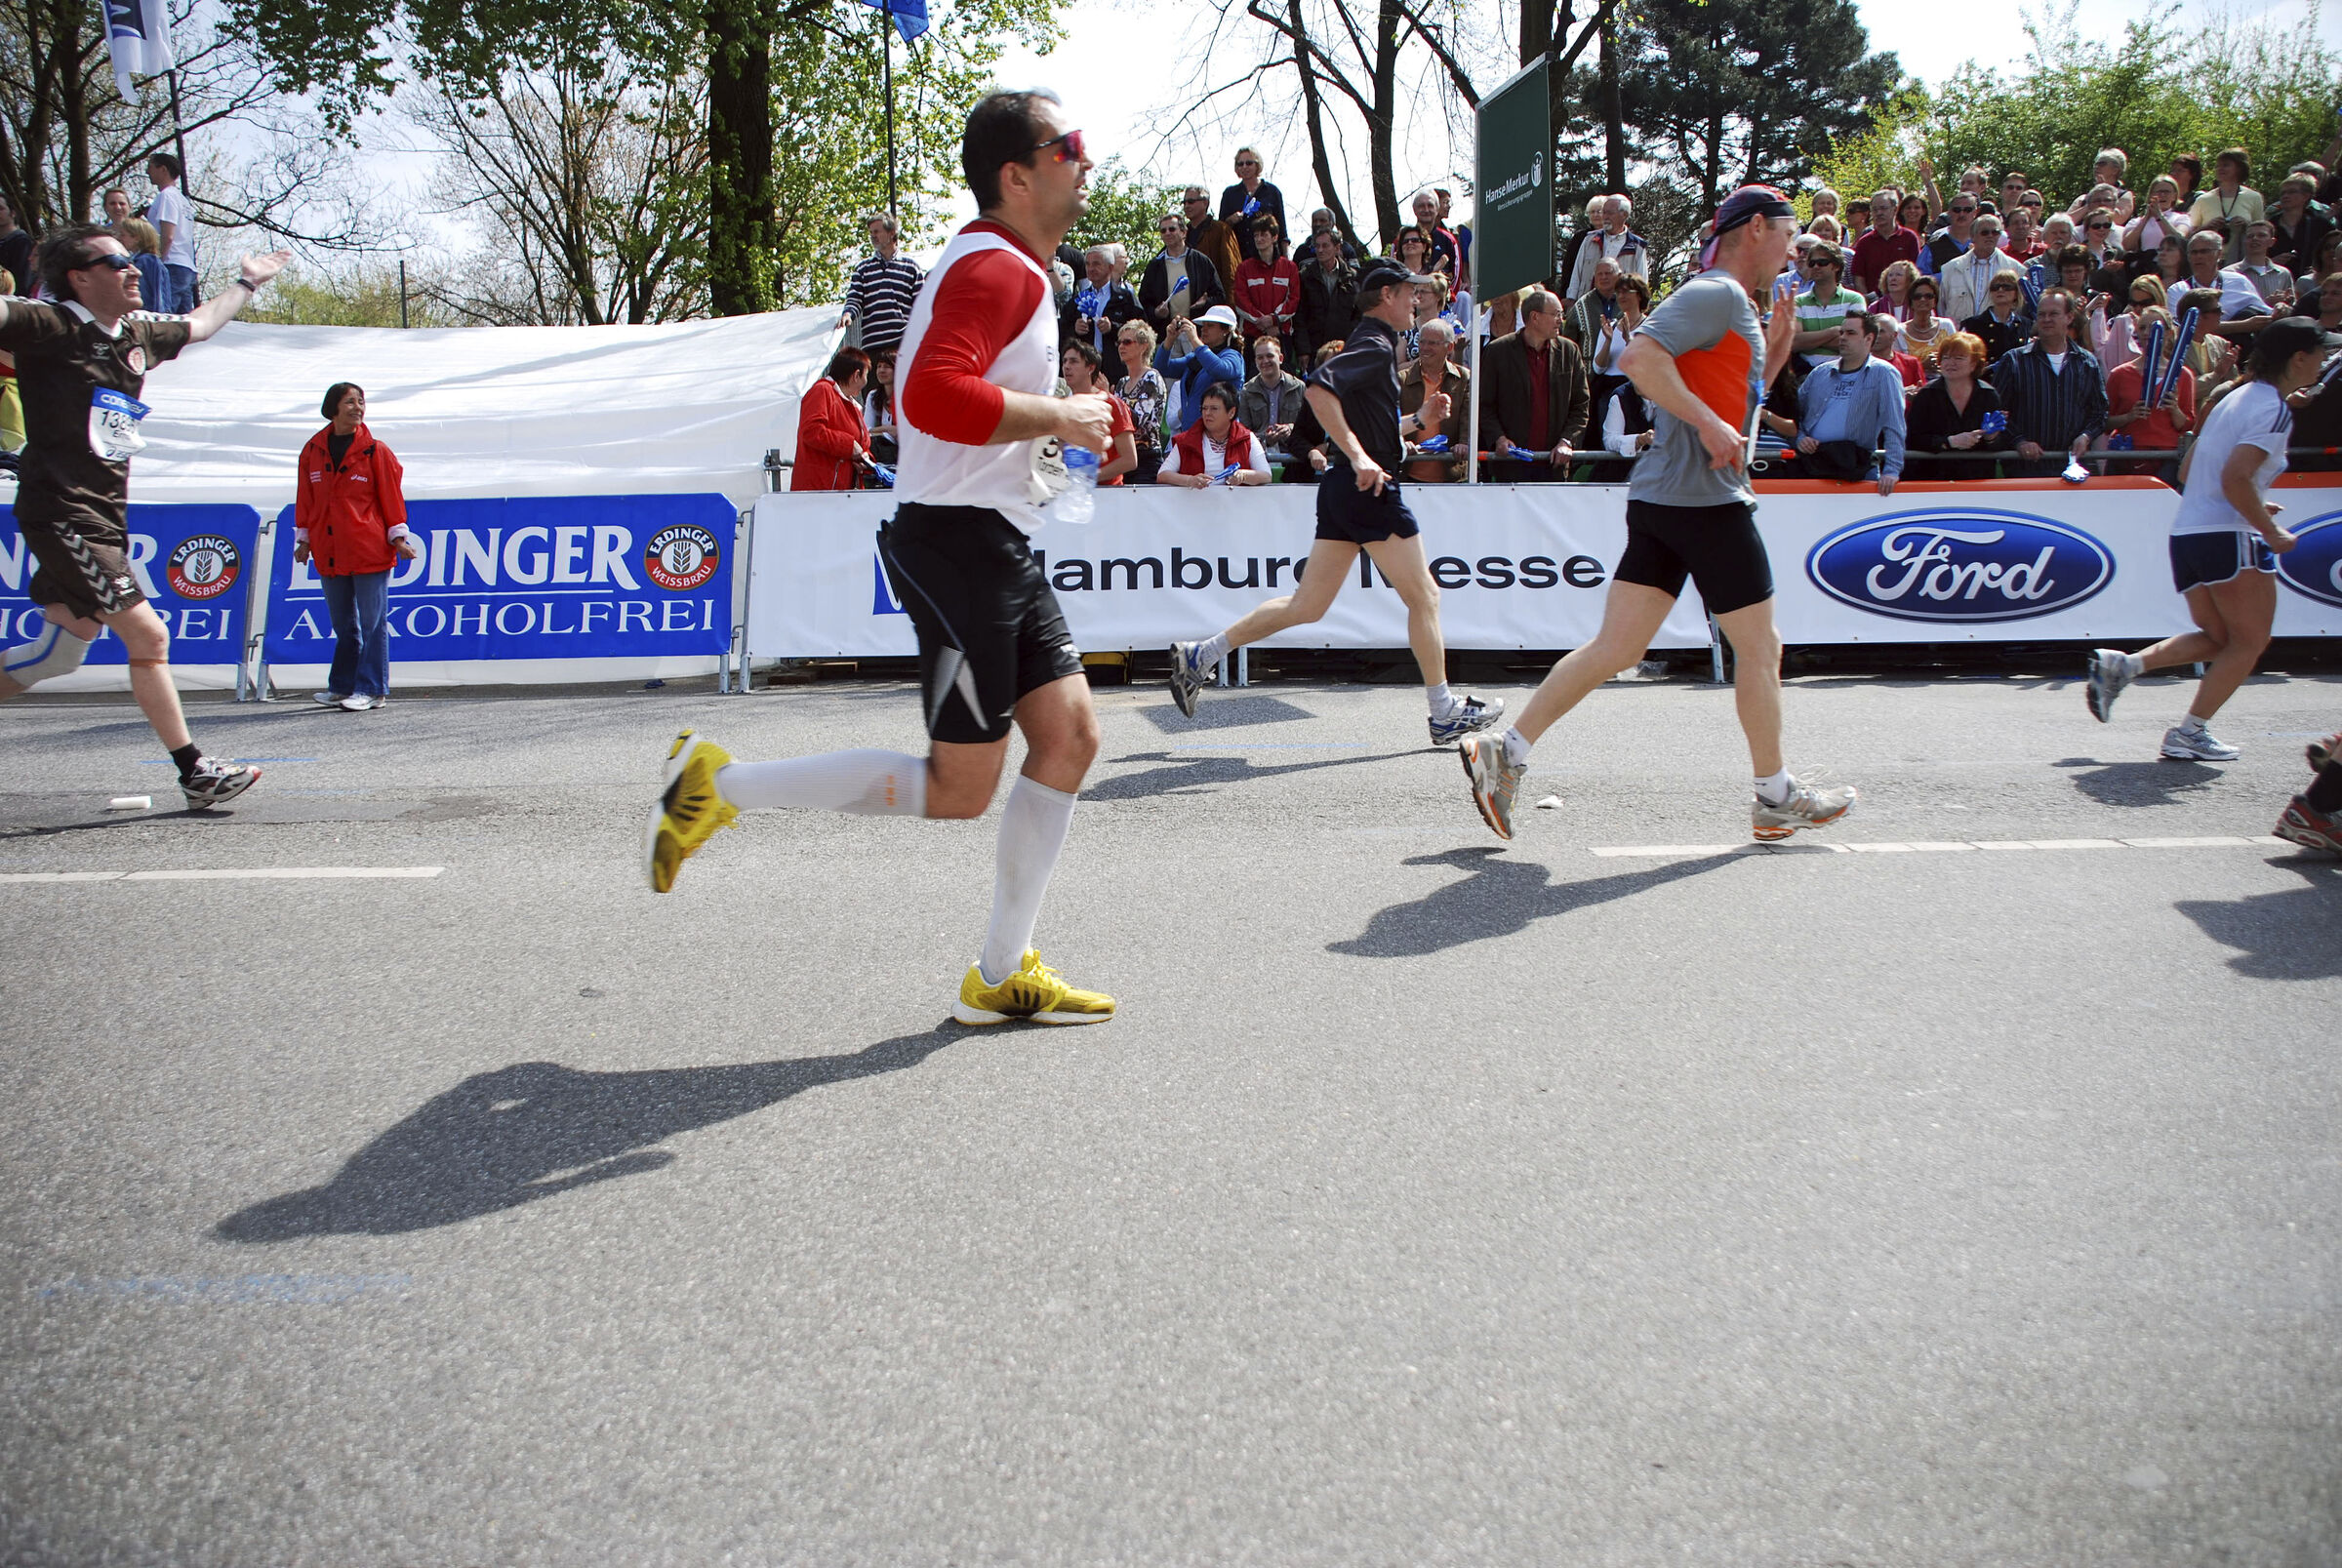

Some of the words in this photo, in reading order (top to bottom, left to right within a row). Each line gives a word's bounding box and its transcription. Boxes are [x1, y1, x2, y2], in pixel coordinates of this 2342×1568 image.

[1485, 172, 1529, 205] HanseMerkur
[173, 538, 236, 563] ERDINGER
[287, 525, 641, 591] EDINGER
[649, 527, 714, 554] ERDINGER
[1866, 527, 2055, 601] Ford
[283, 599, 715, 641] AOHOLFREI
